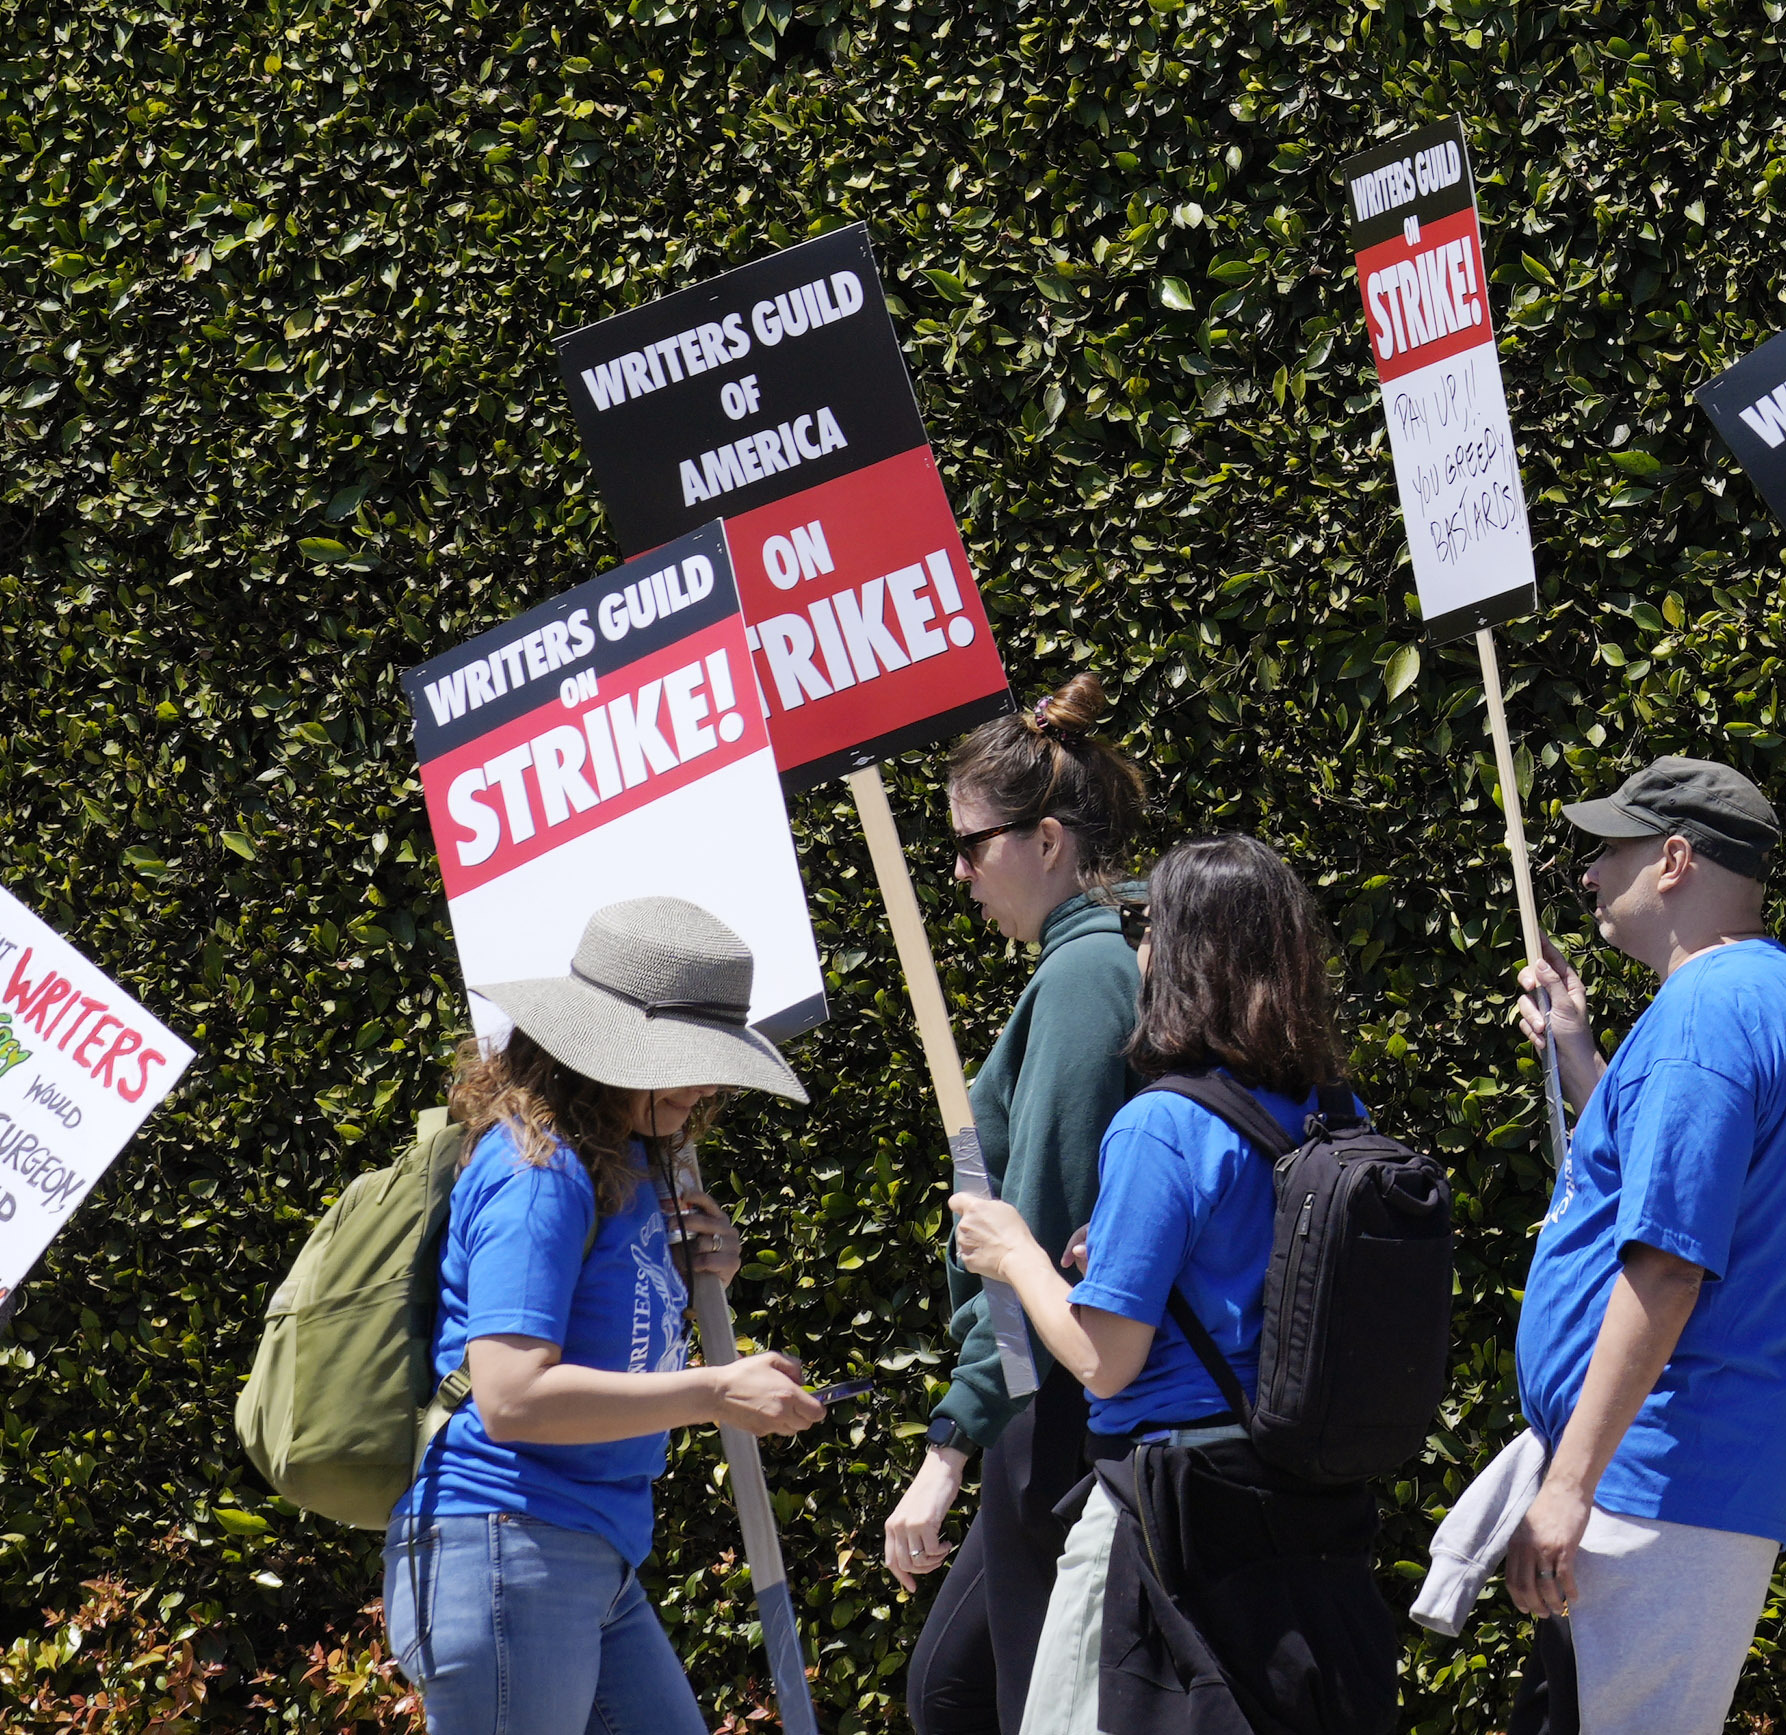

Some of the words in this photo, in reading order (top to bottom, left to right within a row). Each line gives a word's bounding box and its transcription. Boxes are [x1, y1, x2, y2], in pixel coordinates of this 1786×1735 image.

[1351, 158, 1415, 222] WRITERS
[1415, 141, 1461, 197] GUILD
[1404, 215, 1420, 246] ON
[581, 313, 750, 411] WRITERS
[752, 271, 863, 346] GUILD
[1368, 236, 1481, 359] STRIKE!
[721, 375, 760, 420] OF
[1394, 392, 1431, 445] PAY
[680, 407, 847, 506] AMERICA
[1412, 463, 1440, 518] YOU
[1445, 423, 1507, 485] GREEDY
[763, 520, 834, 589] ON
[424, 609, 595, 726] WRITERS
[598, 555, 714, 641] GUILD
[746, 549, 974, 720] RIKE!
[560, 667, 599, 708] ON
[447, 648, 744, 866] STRIKE!
[3, 946, 167, 1104] WRITERS
[24, 1073, 82, 1130] WOULD
